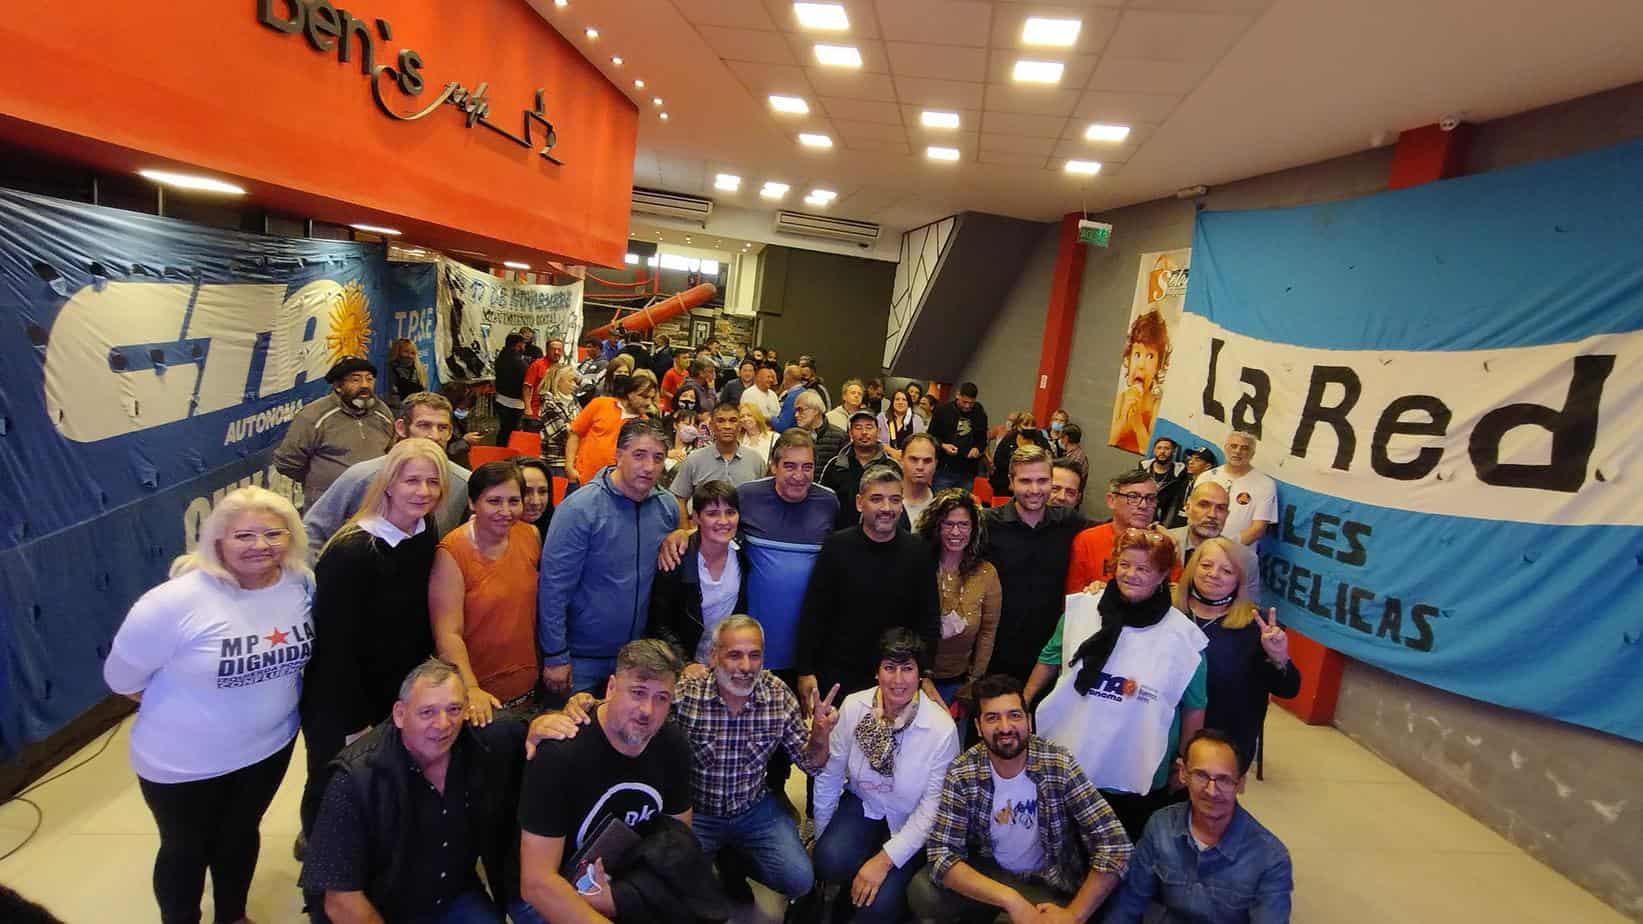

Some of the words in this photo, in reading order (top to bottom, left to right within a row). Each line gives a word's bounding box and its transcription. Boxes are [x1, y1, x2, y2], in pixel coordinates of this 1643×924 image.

[44, 278, 348, 443] CTA
[1202, 337, 1272, 442] La
[1291, 354, 1618, 494] Red
[1272, 503, 1373, 567] LES
[218, 642, 312, 678] DIGNIDA
[291, 621, 316, 643] LA
